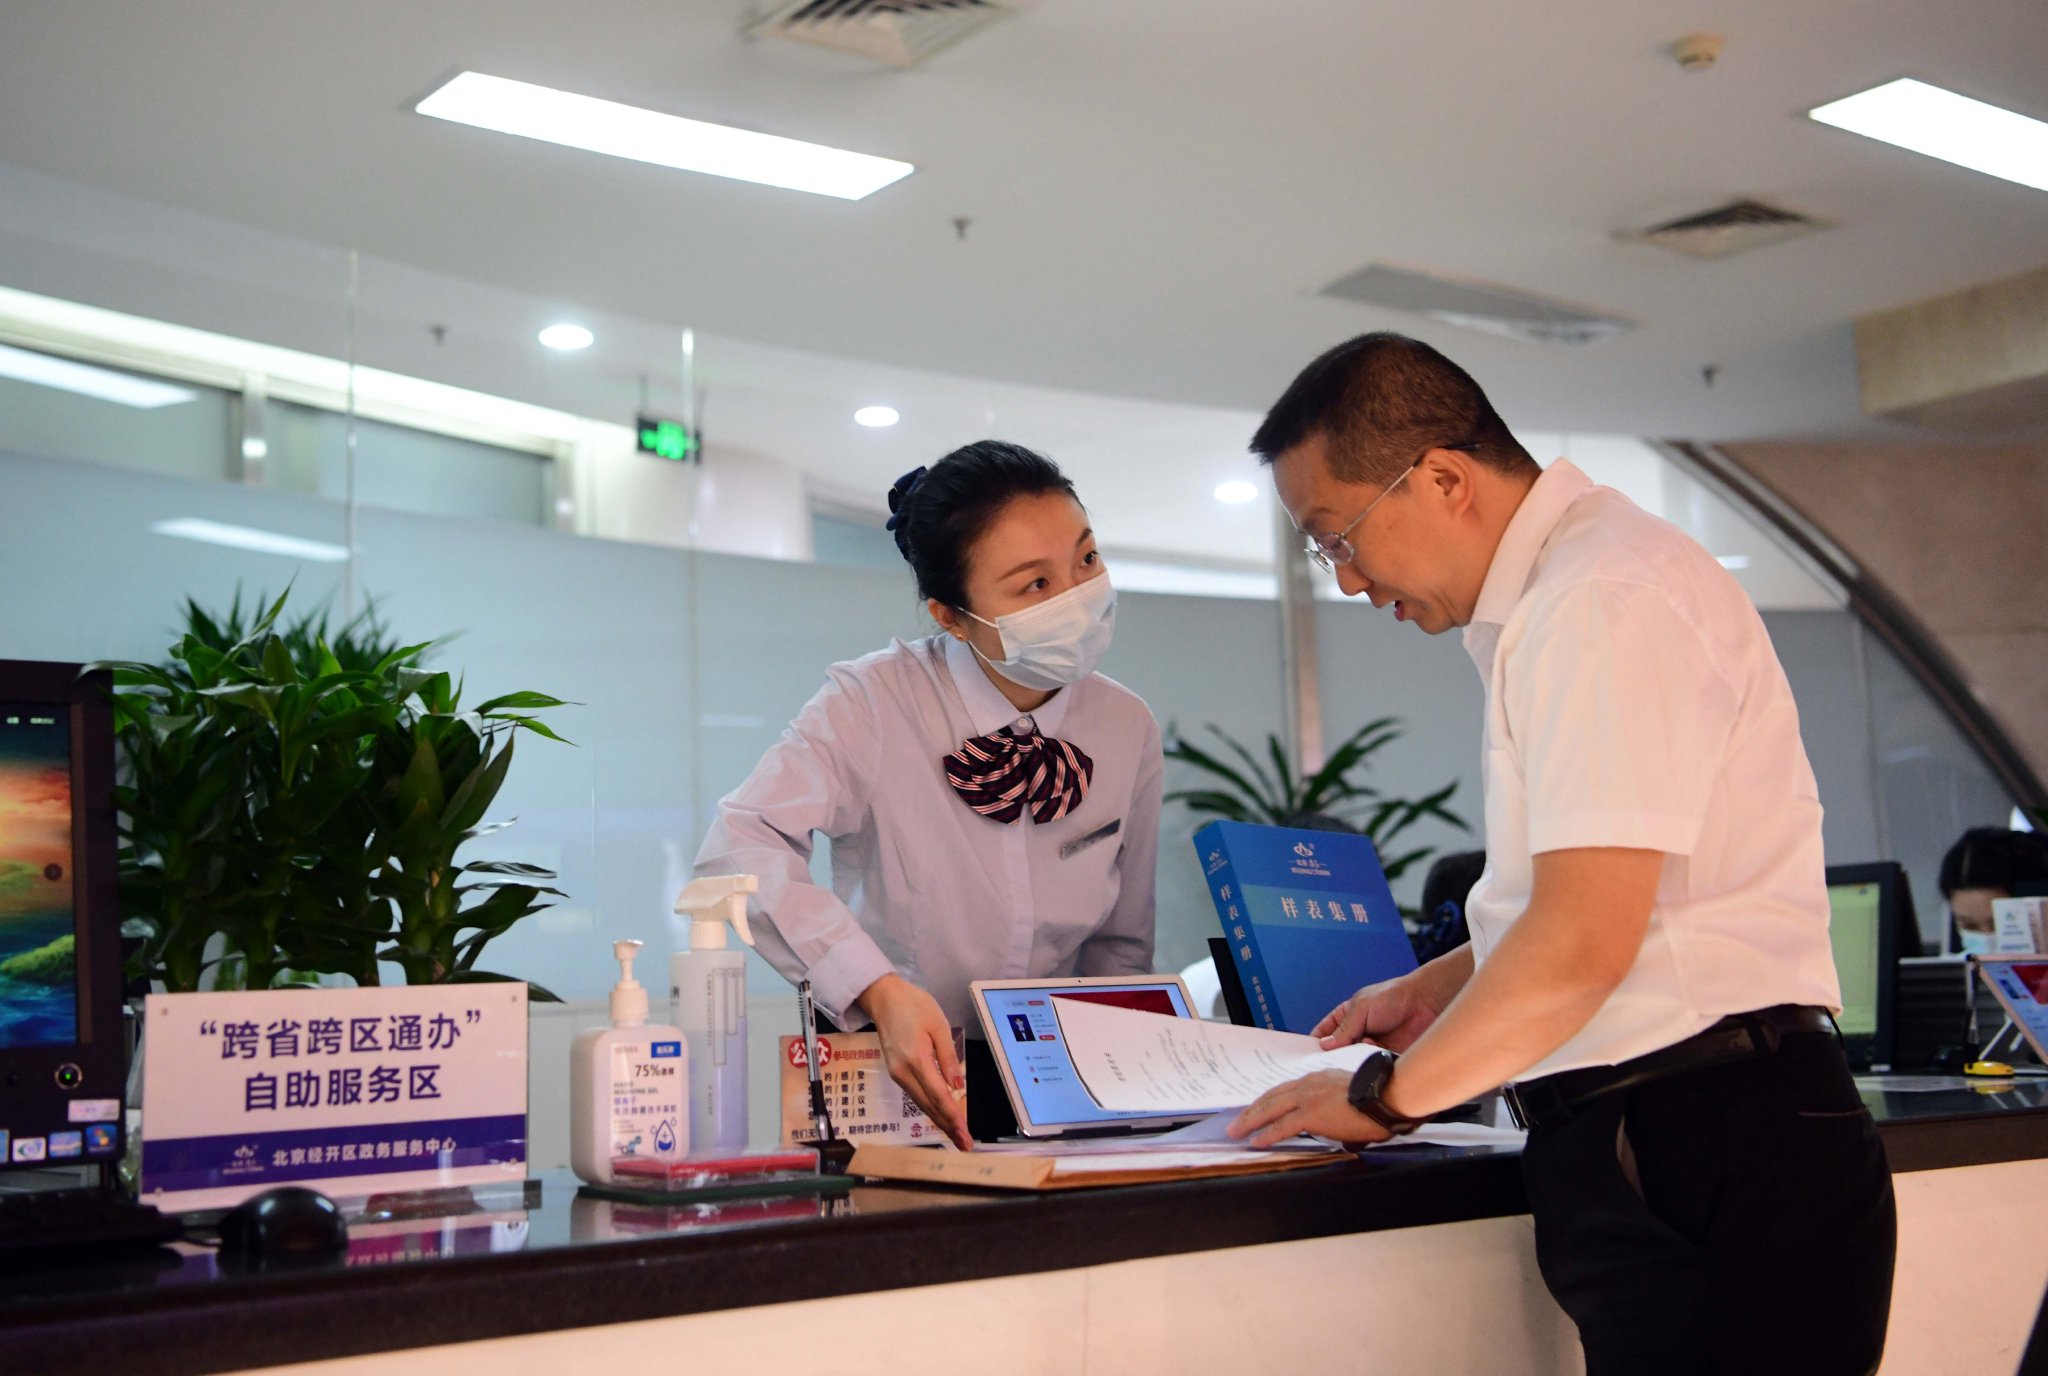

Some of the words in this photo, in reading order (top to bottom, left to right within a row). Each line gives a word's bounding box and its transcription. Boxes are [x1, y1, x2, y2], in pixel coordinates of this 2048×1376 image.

[1280, 896, 1369, 924] 样表集册
[200, 1009, 482, 1060] “跨省跨区通办”
[244, 1064, 442, 1112] 自助服务区
[272, 1137, 458, 1167] 北京经开区政务服务中心
